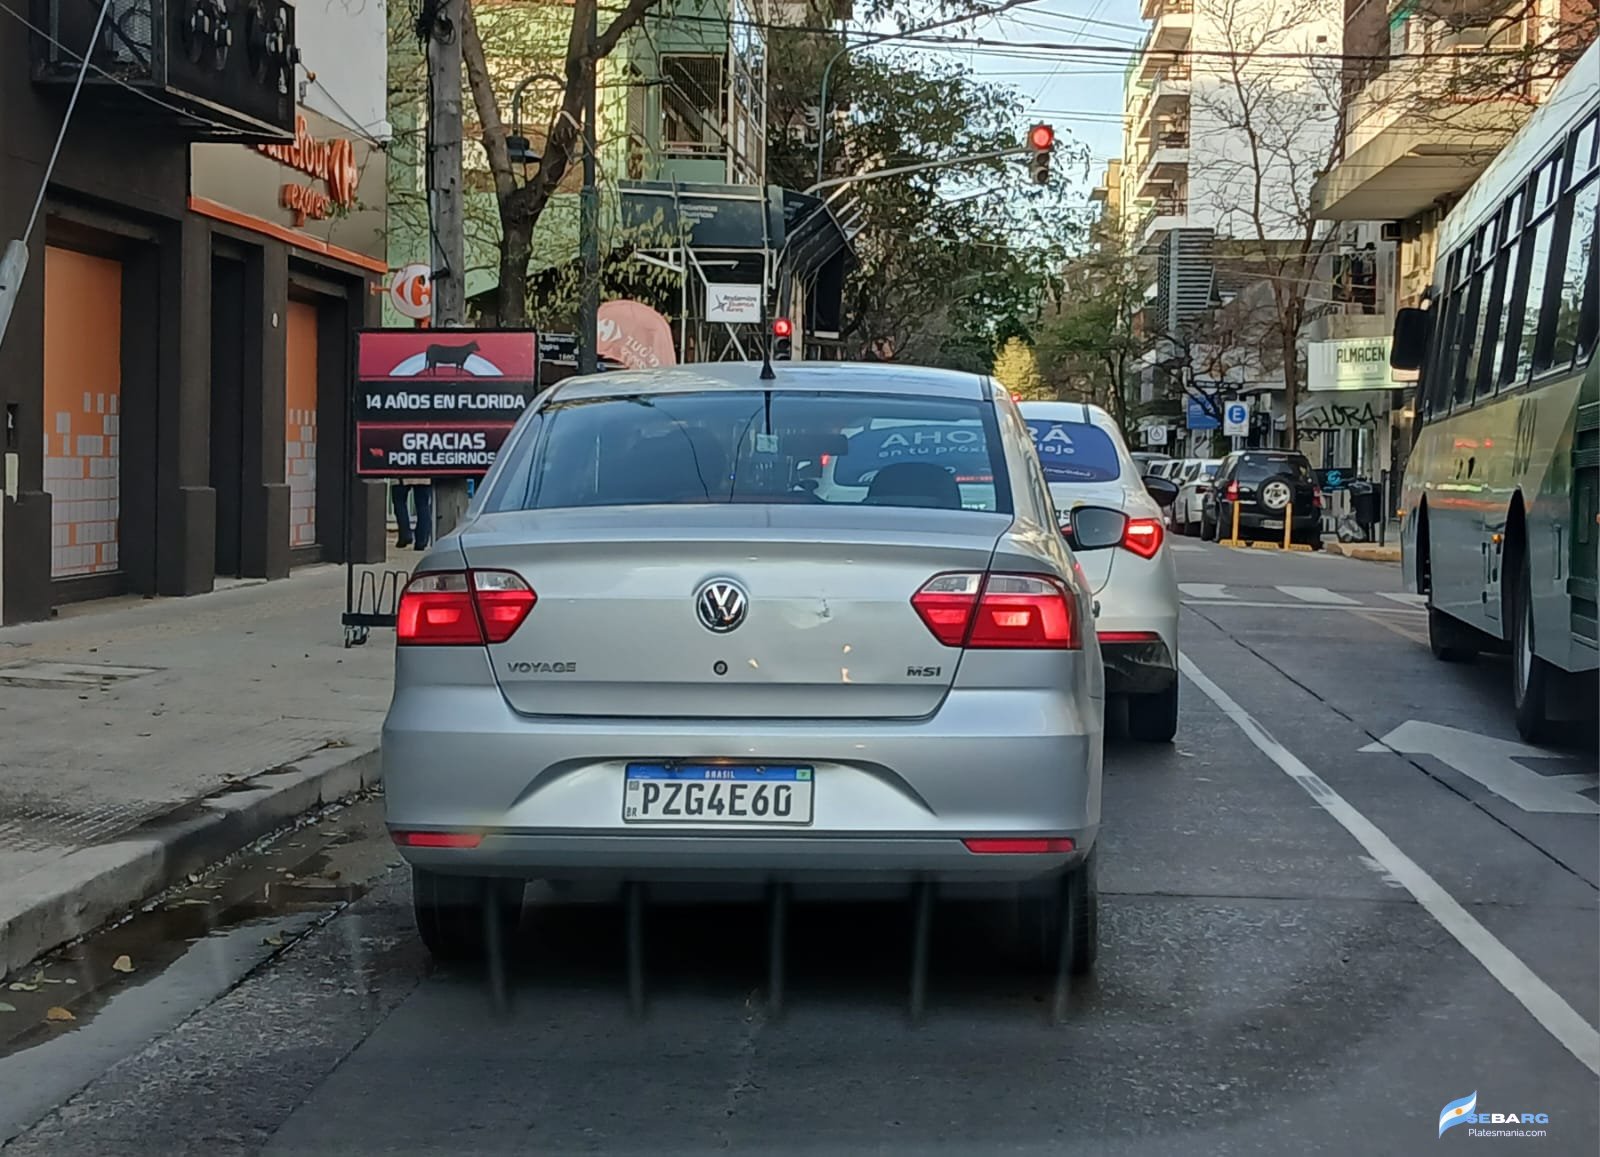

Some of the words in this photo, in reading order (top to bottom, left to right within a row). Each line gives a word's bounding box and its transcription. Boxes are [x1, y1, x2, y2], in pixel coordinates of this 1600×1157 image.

[1336, 347, 1385, 363] ALMACEN
[366, 394, 381, 409] 14
[385, 392, 430, 409] AÑOS
[434, 394, 455, 409] EN
[458, 394, 526, 409] FLORIDA
[1232, 407, 1242, 421] E
[402, 433, 486, 450] GRACIAS
[909, 447, 930, 455] tu
[1033, 443, 1075, 455] iaje
[389, 452, 417, 465] POR
[421, 452, 496, 465] ELEGIRNOS
[506, 662, 577, 673] VOYAGE
[907, 666, 941, 677] MSI
[705, 770, 736, 779] BRASIL
[642, 783, 792, 817] PZG4E60
[626, 807, 637, 817] BR
